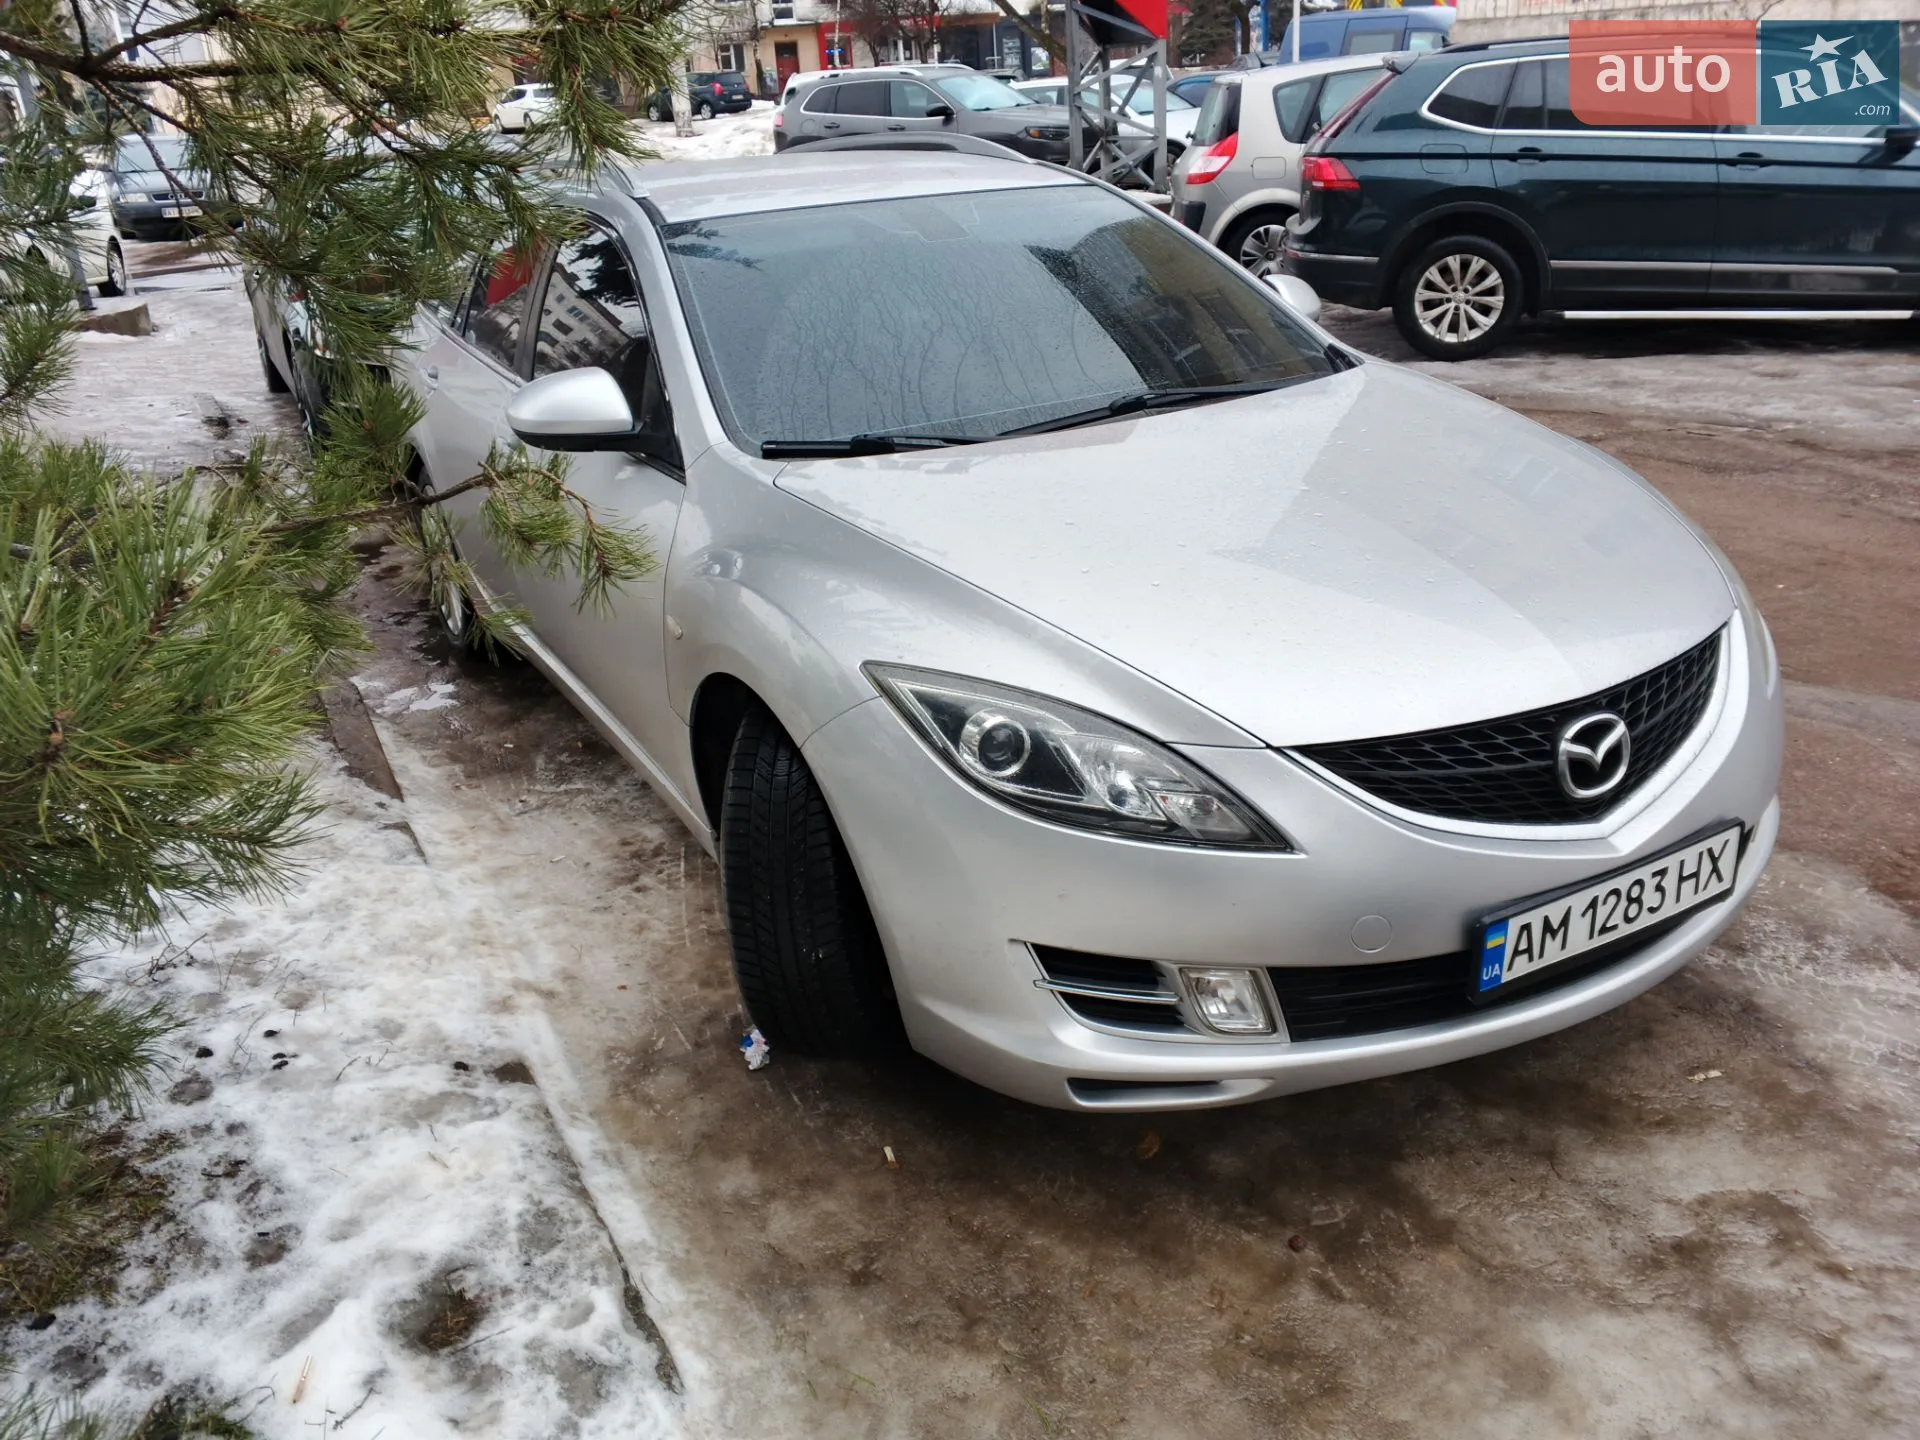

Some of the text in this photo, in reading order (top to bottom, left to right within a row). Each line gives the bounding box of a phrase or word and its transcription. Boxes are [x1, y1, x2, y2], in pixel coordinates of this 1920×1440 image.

[1506, 838, 1730, 972] AM 1283 HX
[1483, 963, 1501, 980] UA
